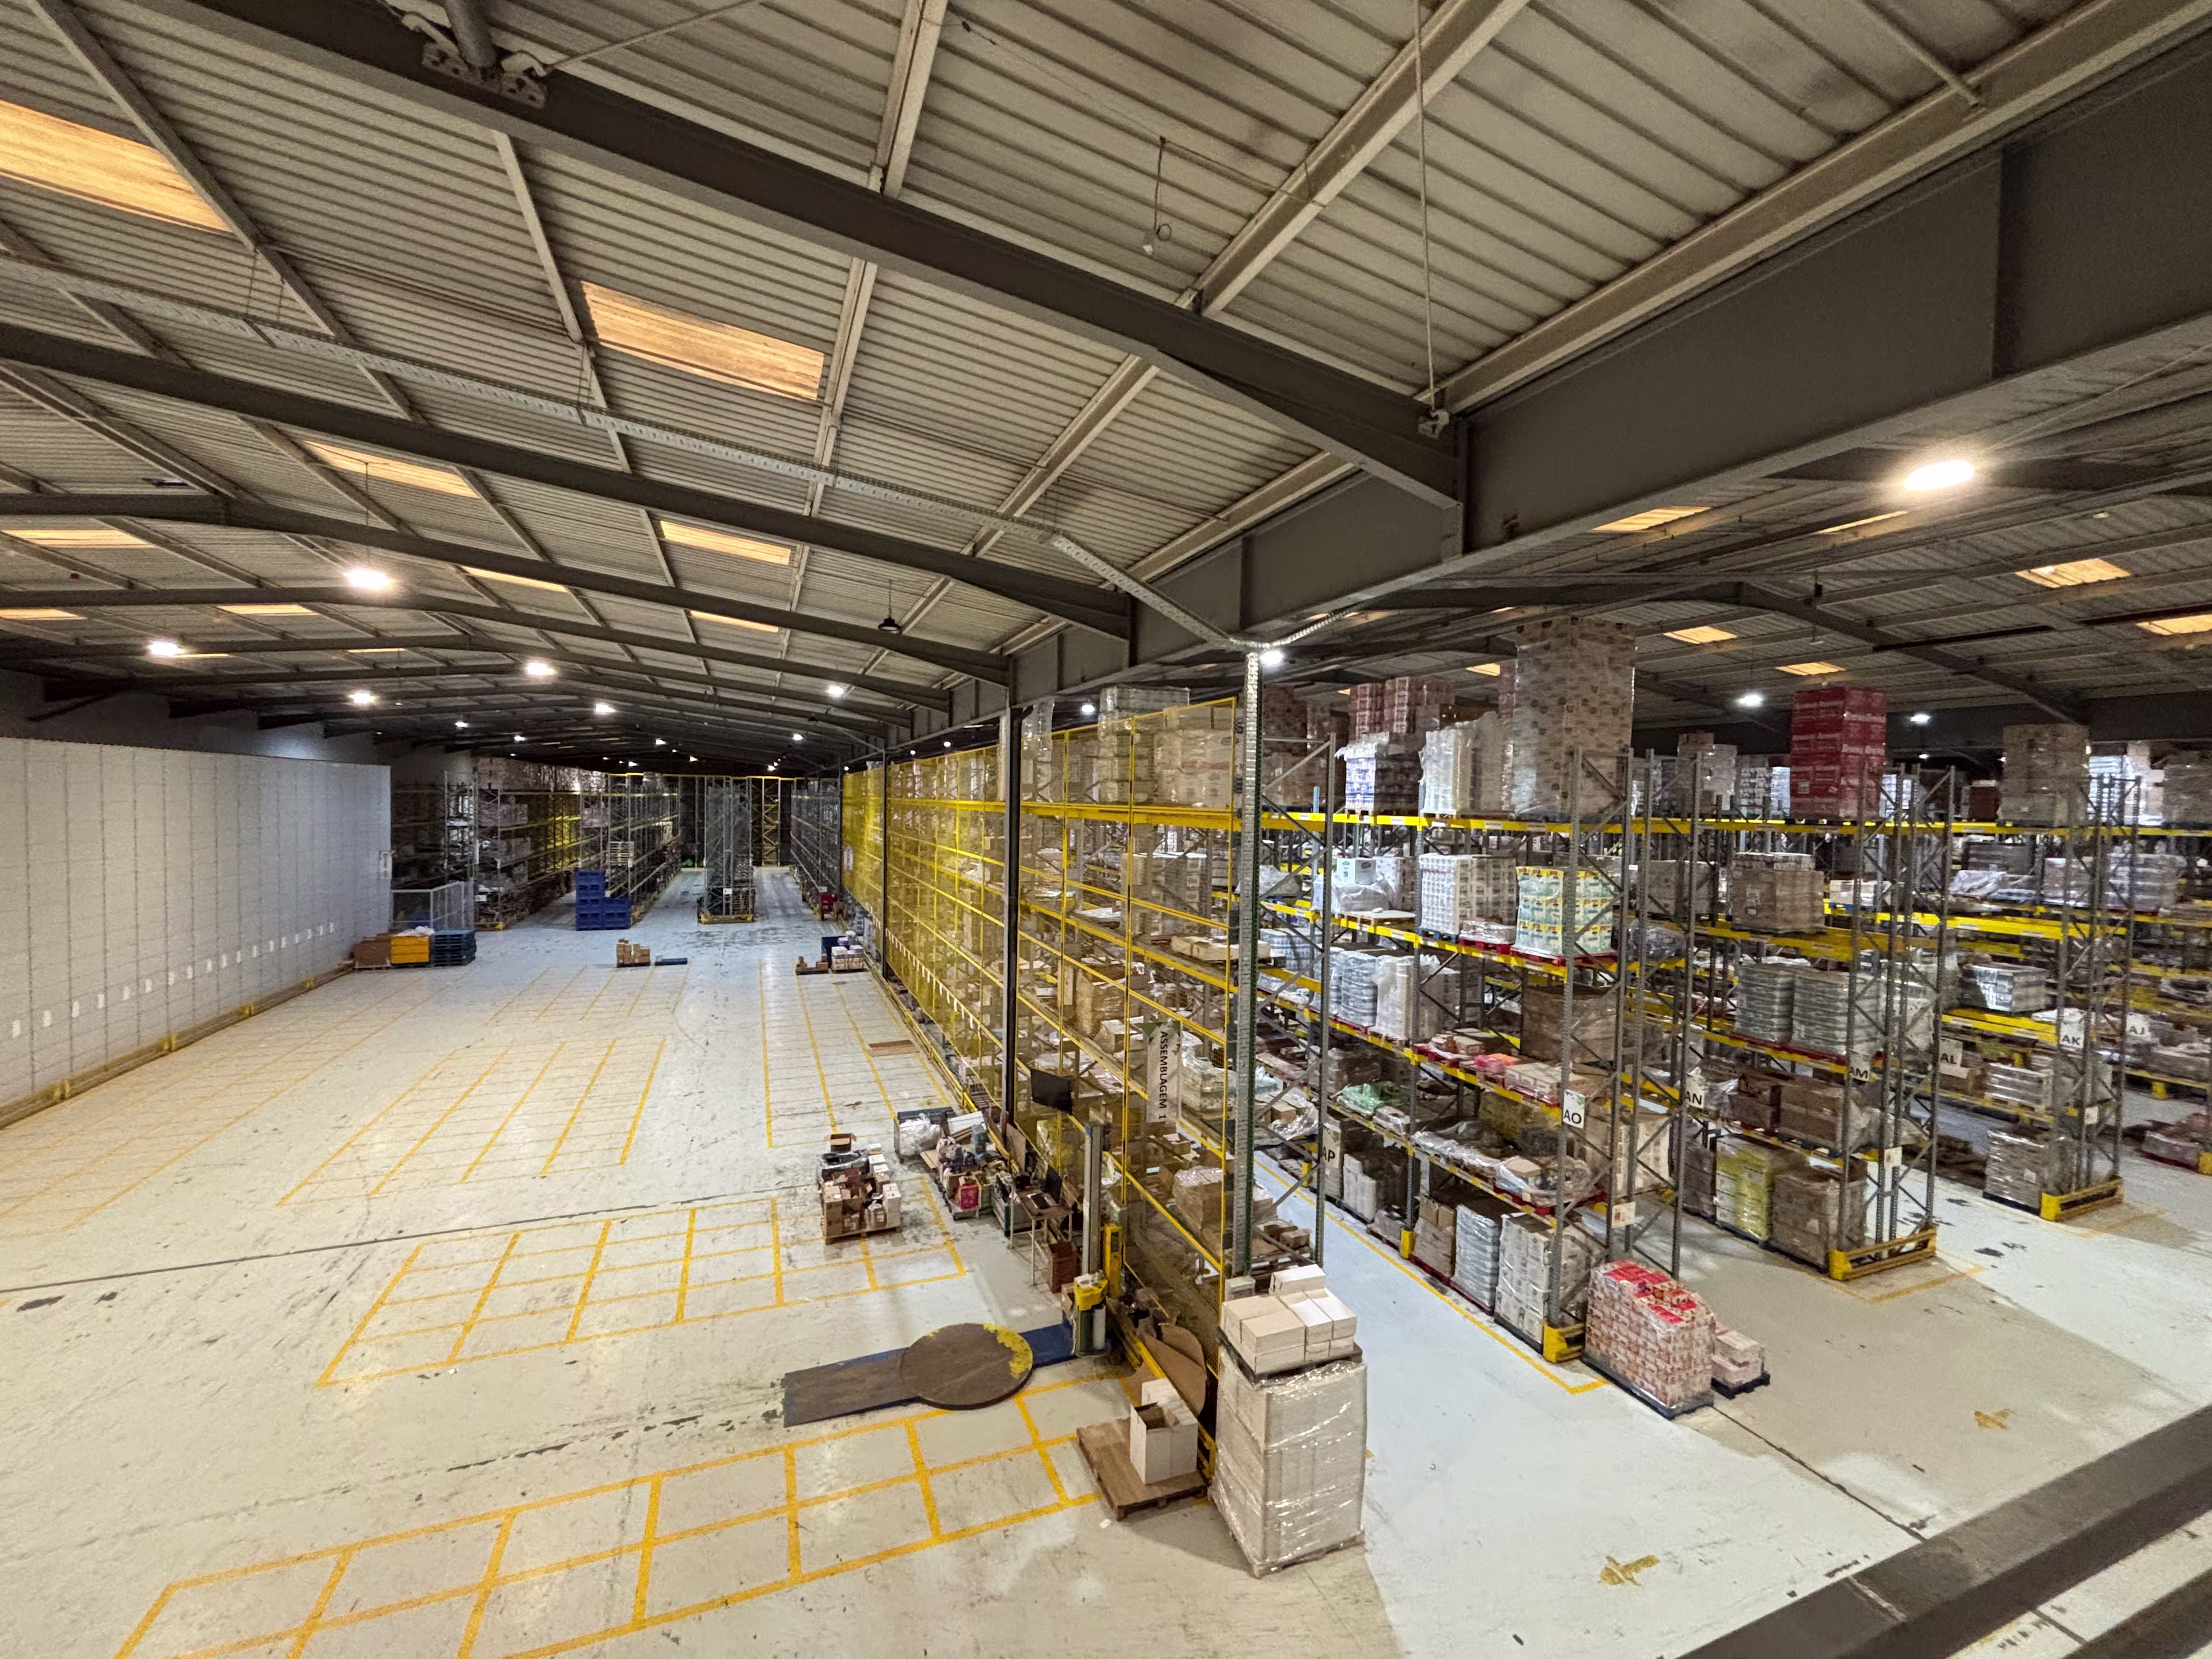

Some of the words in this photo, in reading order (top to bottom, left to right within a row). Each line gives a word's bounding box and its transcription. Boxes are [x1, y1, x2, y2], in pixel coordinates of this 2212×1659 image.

[2062, 1035, 2081, 1046] AK
[1940, 1053, 1957, 1065] AL
[1159, 1031, 1168, 1108] ASSEMBLAGEM
[1564, 1109, 1582, 1124] AO
